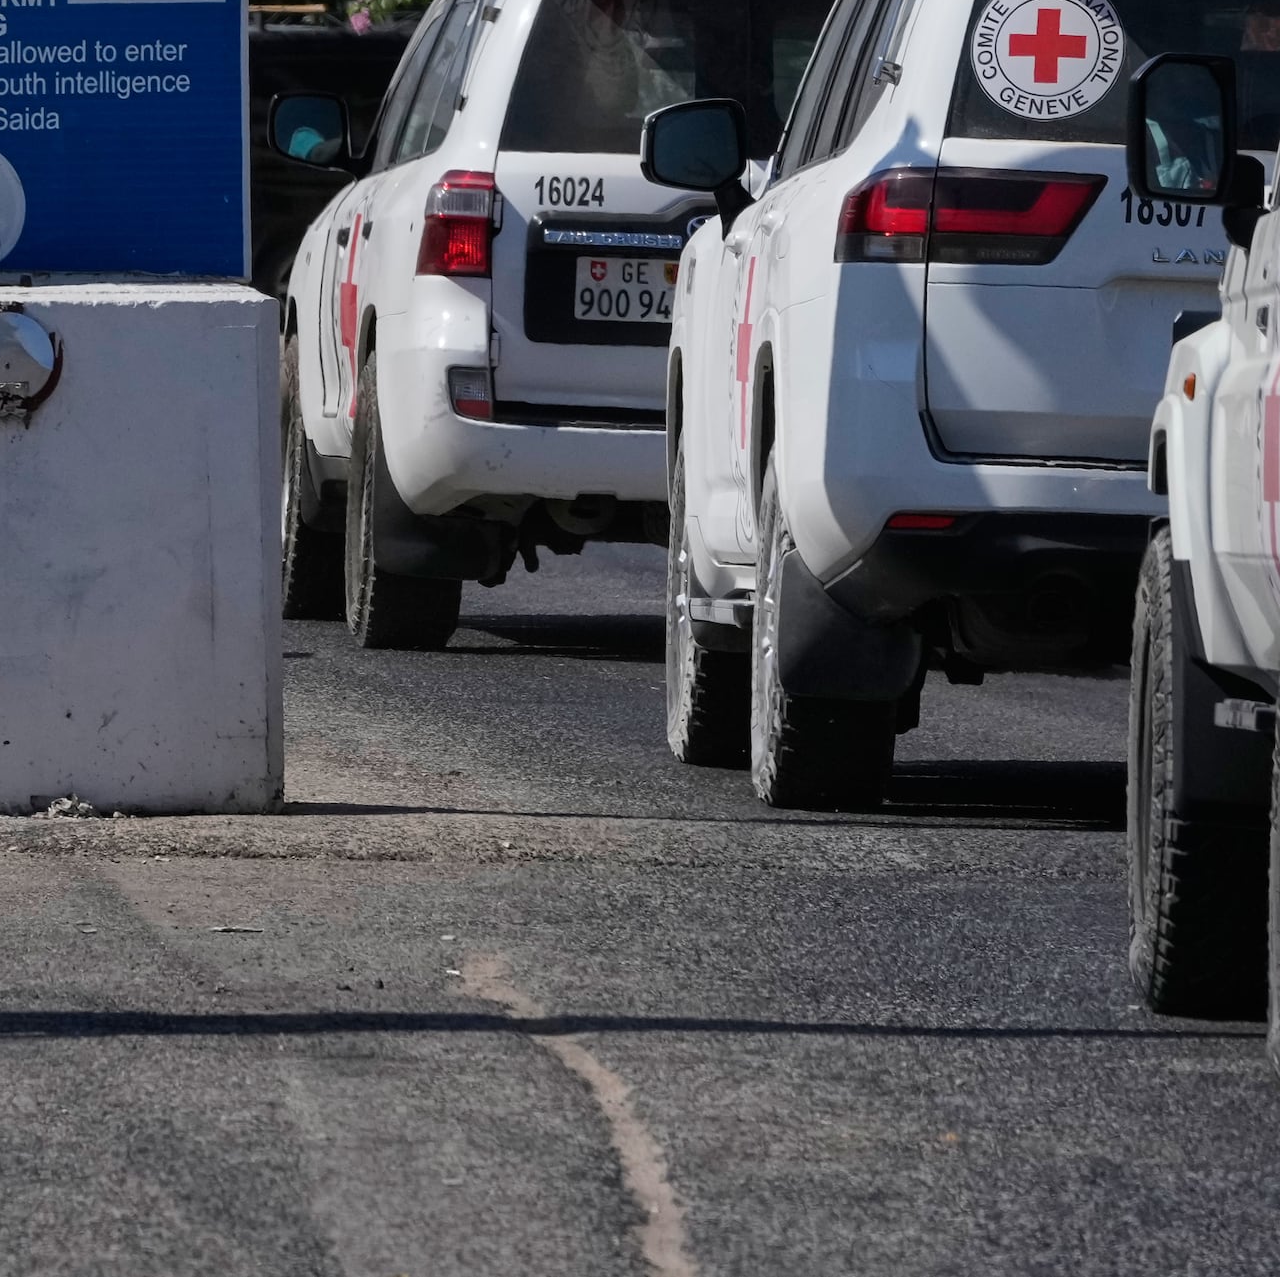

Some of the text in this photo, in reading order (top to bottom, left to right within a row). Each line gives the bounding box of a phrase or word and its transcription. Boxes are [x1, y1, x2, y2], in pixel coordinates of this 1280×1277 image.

[94, 40, 117, 62] to
[125, 39, 188, 62] enter
[976, 0, 1010, 80] COMITE
[55, 70, 190, 100] intelligence
[999, 86, 1089, 116] GENEVE
[534, 175, 605, 208] 16024
[1151, 246, 1226, 265] LAN
[621, 262, 650, 285] GE
[580, 287, 672, 320] 900 94
